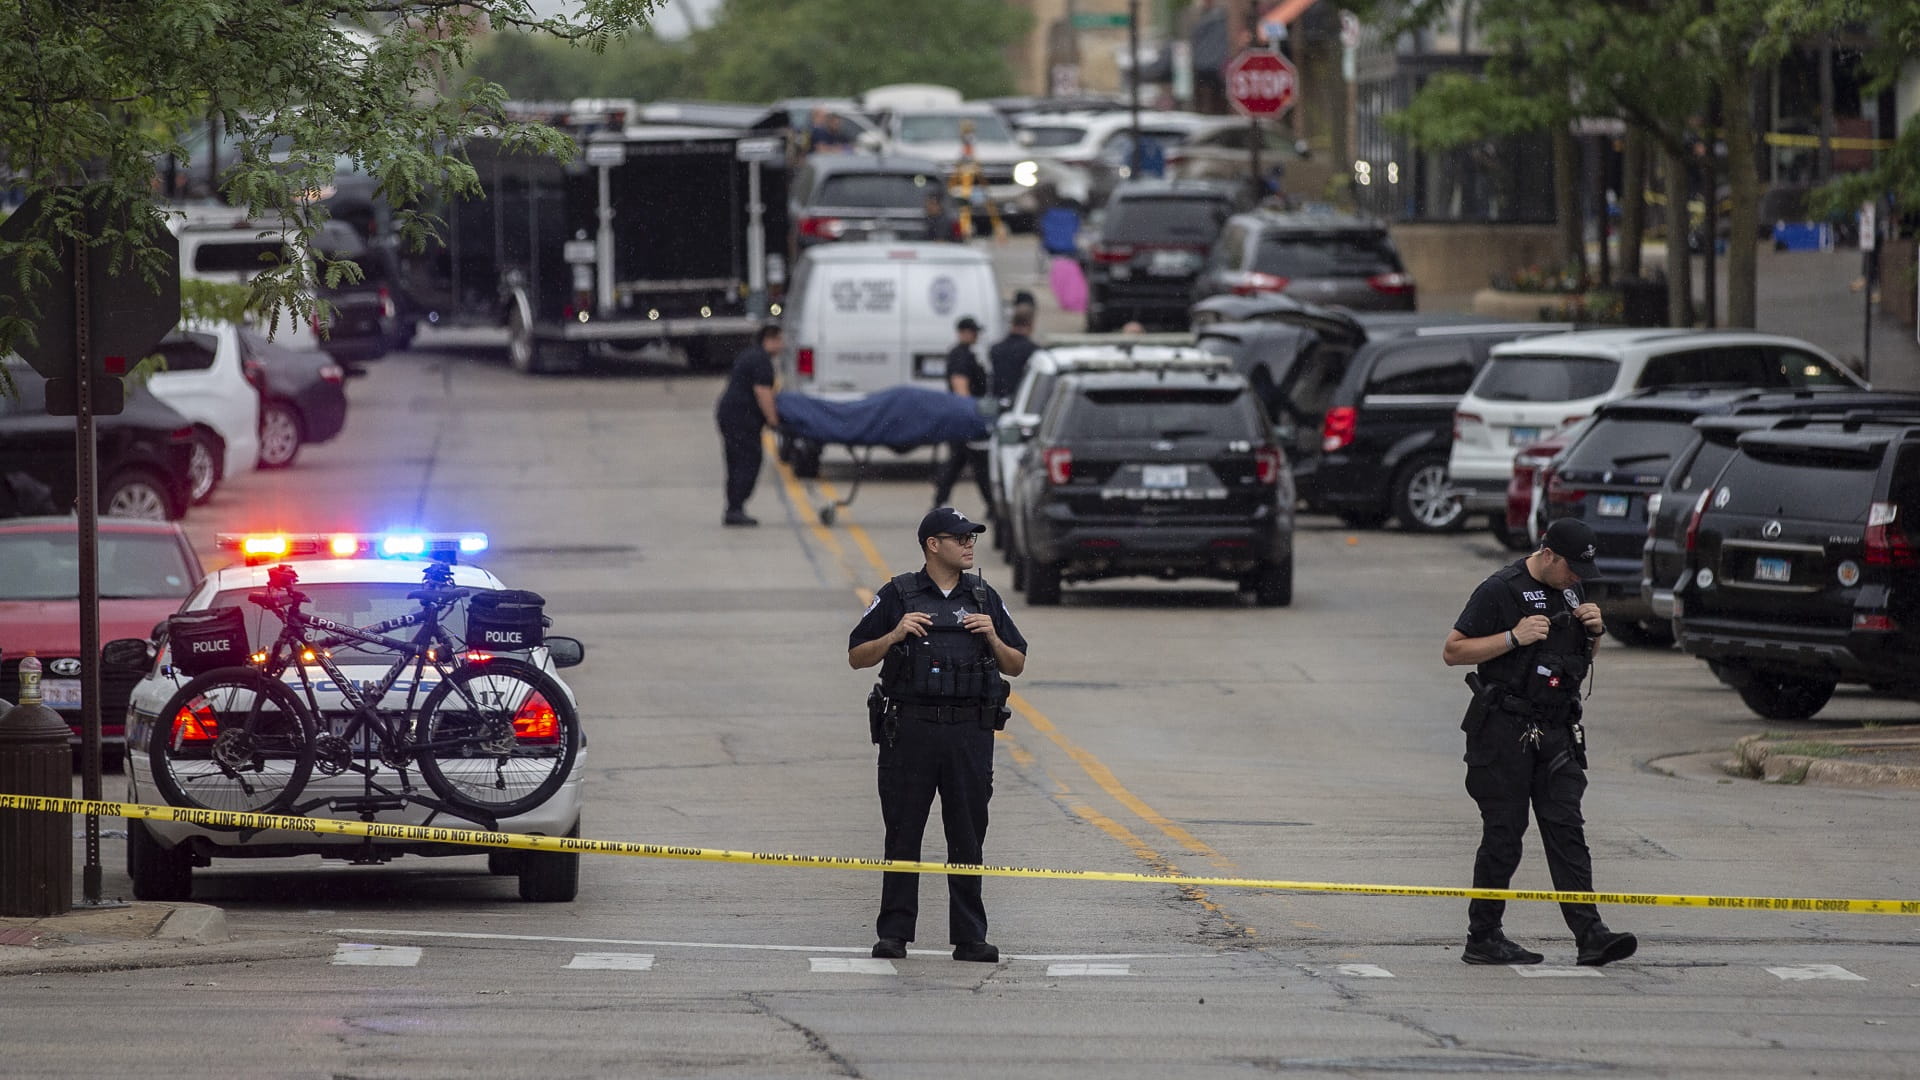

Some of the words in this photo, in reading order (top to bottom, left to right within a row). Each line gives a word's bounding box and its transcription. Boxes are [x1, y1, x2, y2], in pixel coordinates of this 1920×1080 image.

[1233, 70, 1292, 98] STOP
[1523, 590, 1547, 601] POLICE
[309, 616, 336, 630] LPD
[485, 631, 523, 643] POLICE
[192, 639, 231, 654] POLICE
[28, 673, 38, 684] G
[480, 691, 505, 705] 17
[18, 797, 41, 811] LINE
[45, 800, 58, 812] DO
[63, 801, 83, 814] NOT
[86, 802, 121, 816] CROSS
[173, 809, 210, 824] POLICE
[214, 812, 236, 826] LINE
[240, 814, 253, 828] DO
[258, 816, 278, 828] NOT
[282, 817, 316, 831] CROSS
[367, 824, 404, 838] POLICE
[408, 827, 429, 839] LINE
[434, 829, 447, 840] DO
[451, 830, 472, 842] NOT
[475, 832, 509, 844] CROSS
[560, 839, 596, 850] POLICE
[600, 842, 622, 851] LINE
[627, 843, 640, 852] DO
[644, 845, 663, 854] NOT
[668, 847, 701, 855] CROSS
